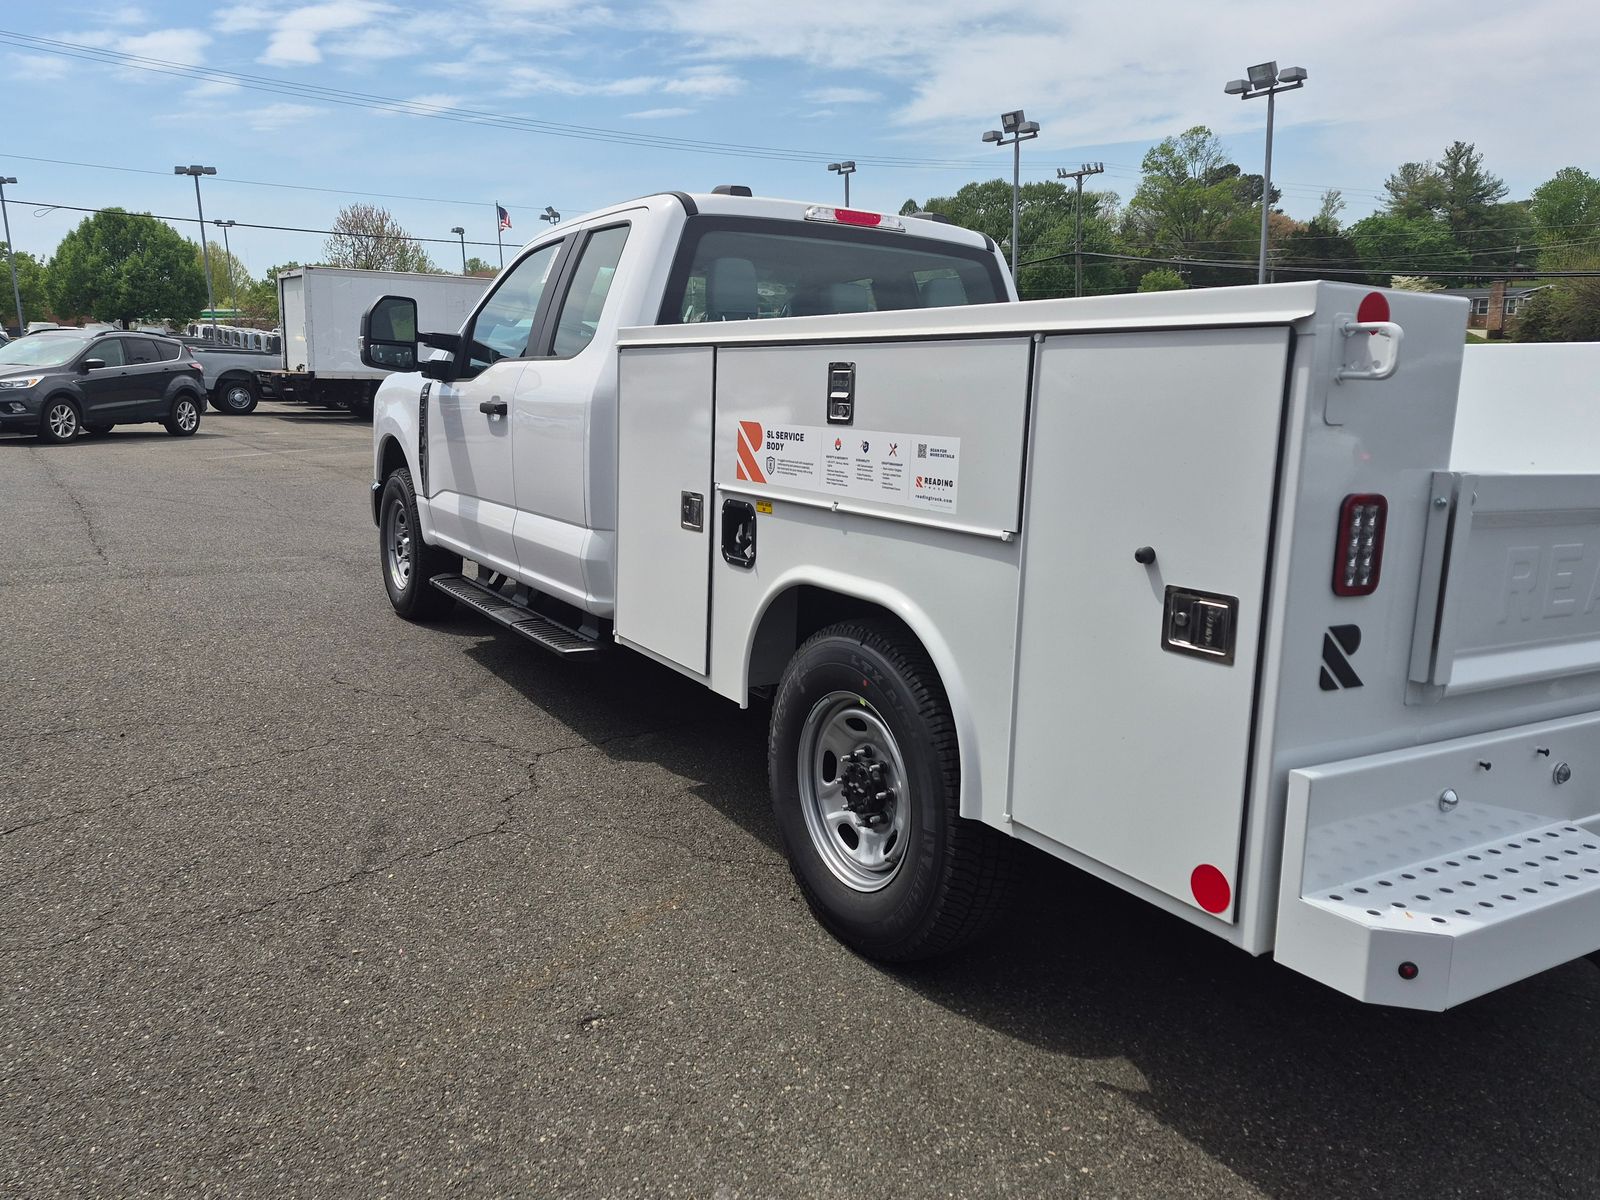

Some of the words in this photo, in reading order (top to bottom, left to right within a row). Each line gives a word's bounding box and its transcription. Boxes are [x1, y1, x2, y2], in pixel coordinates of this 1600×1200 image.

[766, 430, 775, 439] SL
[775, 431, 805, 442] SERVICE
[766, 441, 785, 451] BODY
[924, 477, 954, 488] READING
